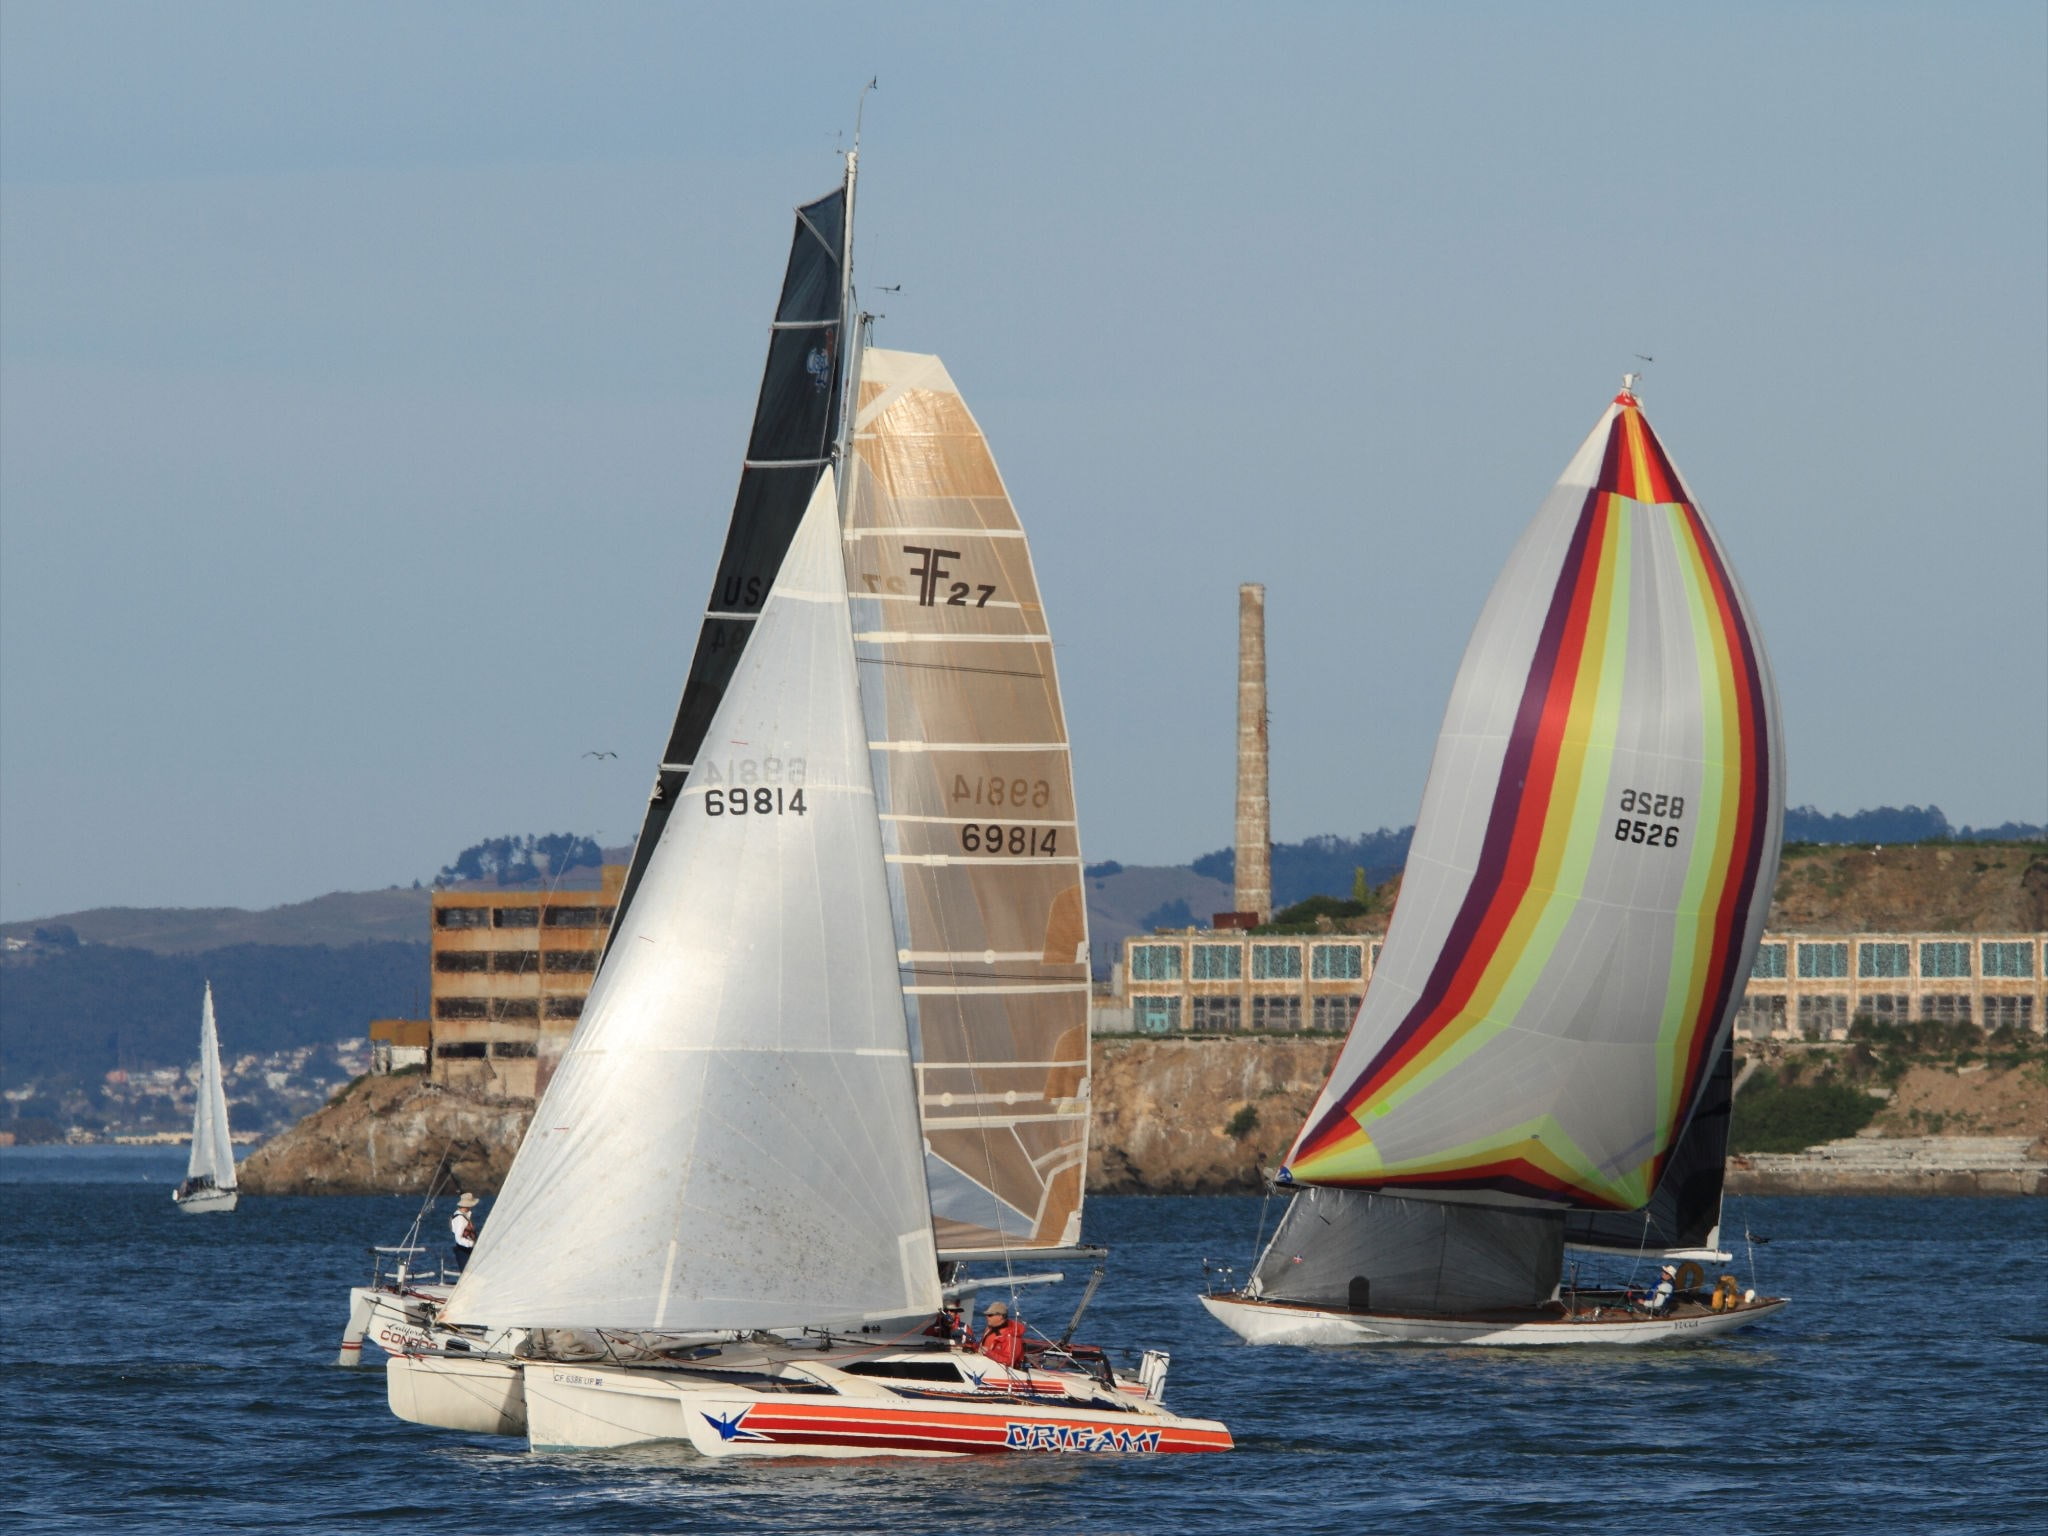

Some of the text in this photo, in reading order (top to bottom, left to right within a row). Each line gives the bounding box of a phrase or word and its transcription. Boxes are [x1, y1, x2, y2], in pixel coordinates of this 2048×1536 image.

[724, 576, 776, 607] US
[946, 582, 996, 608] 27
[705, 787, 808, 817] 69814
[962, 823, 1057, 857] 69814
[1614, 818, 1679, 848] 8526
[1006, 1422, 1162, 1453] ORIGAMI
